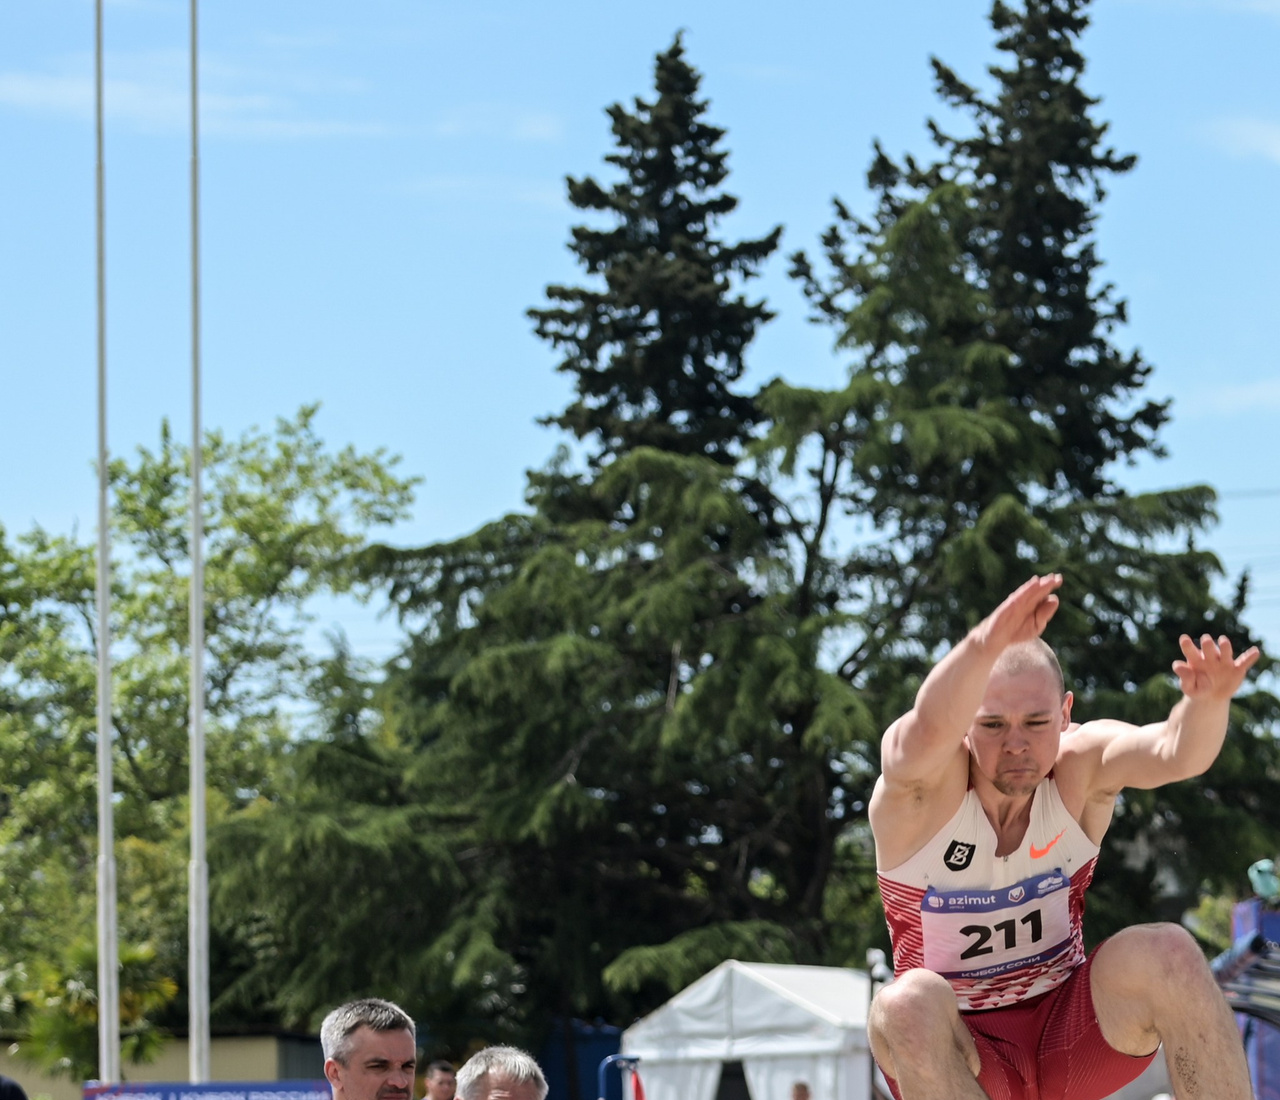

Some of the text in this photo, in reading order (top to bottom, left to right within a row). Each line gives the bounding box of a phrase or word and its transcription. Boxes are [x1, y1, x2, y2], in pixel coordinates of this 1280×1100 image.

[948, 895, 996, 905] azimut
[959, 909, 1043, 960] 211
[961, 955, 1041, 978] КУБОК СОЧИ
